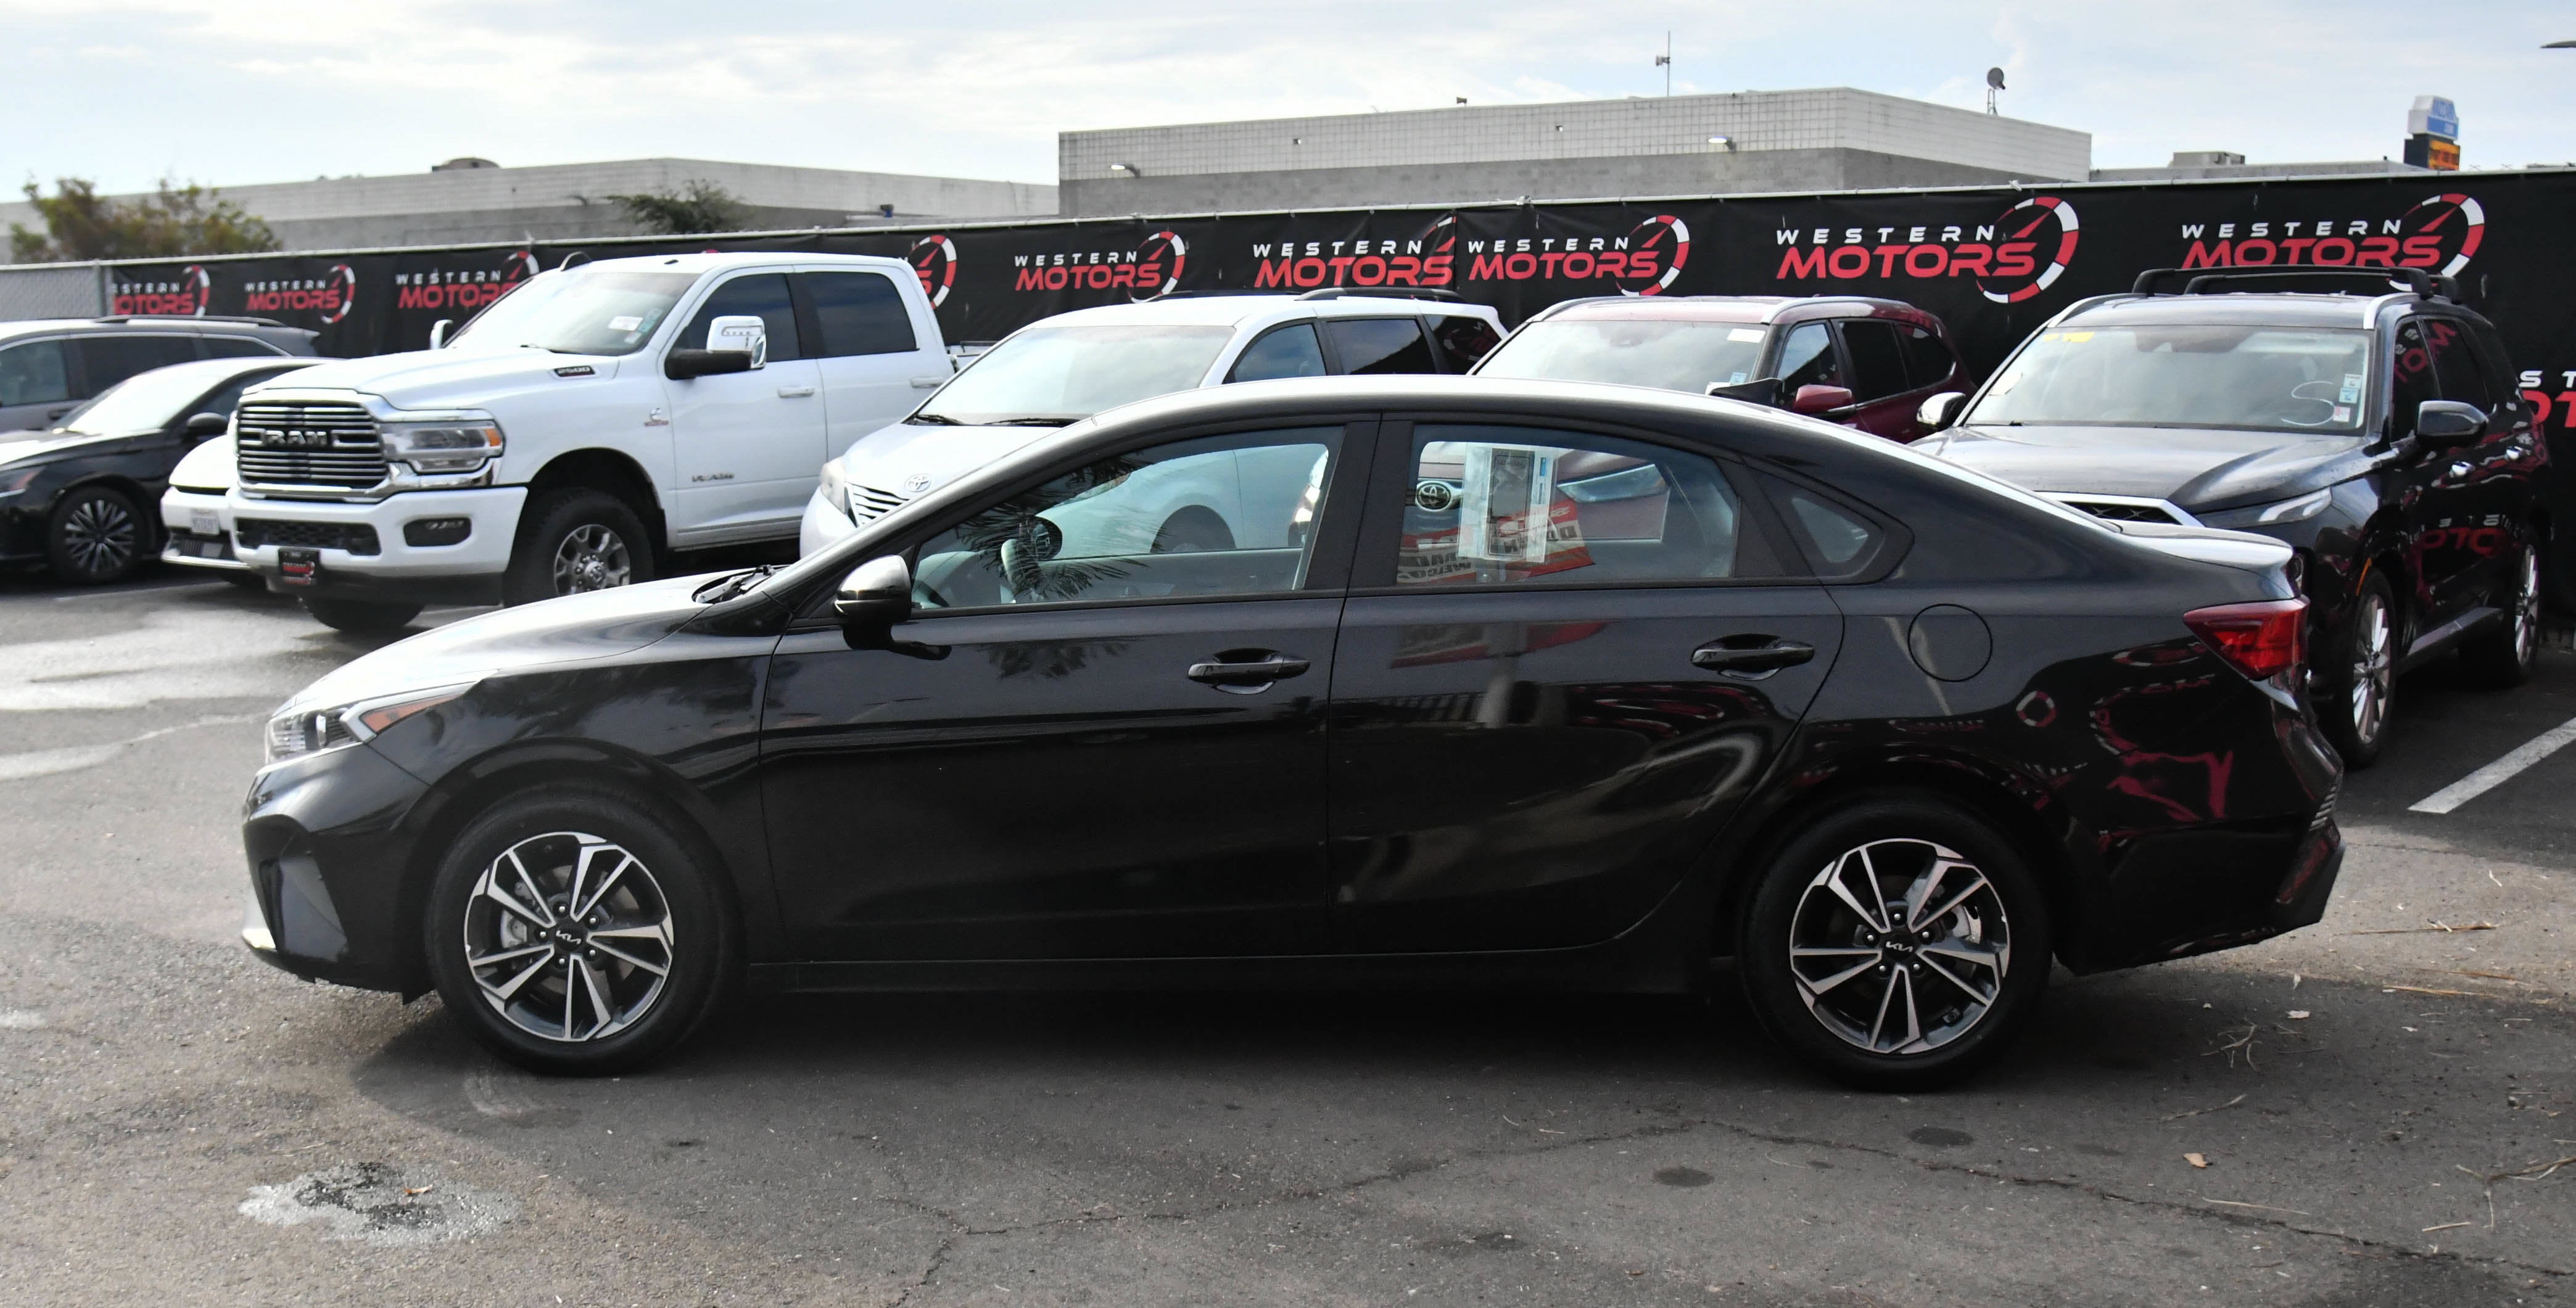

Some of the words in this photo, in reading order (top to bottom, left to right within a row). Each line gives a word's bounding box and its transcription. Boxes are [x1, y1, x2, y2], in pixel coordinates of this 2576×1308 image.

[1777, 225, 1995, 245] WESTERN
[2181, 220, 2401, 239] WESTERN
[1253, 240, 1422, 258] WESTERN
[1468, 237, 1629, 253] WESTERN
[2181, 235, 2442, 269] MOTORS
[1015, 251, 1137, 266] WESTERN
[1469, 250, 1659, 281] MOTORS
[1776, 242, 2037, 279] MOTORS
[396, 270, 501, 285] WESTERN
[1015, 263, 1162, 291] MOTORS
[1254, 254, 1454, 288] MOTORS
[244, 279, 326, 292] WESTERN
[114, 292, 194, 315] OTORS
[248, 290, 341, 311] MOTORS
[265, 430, 328, 445] RAM
